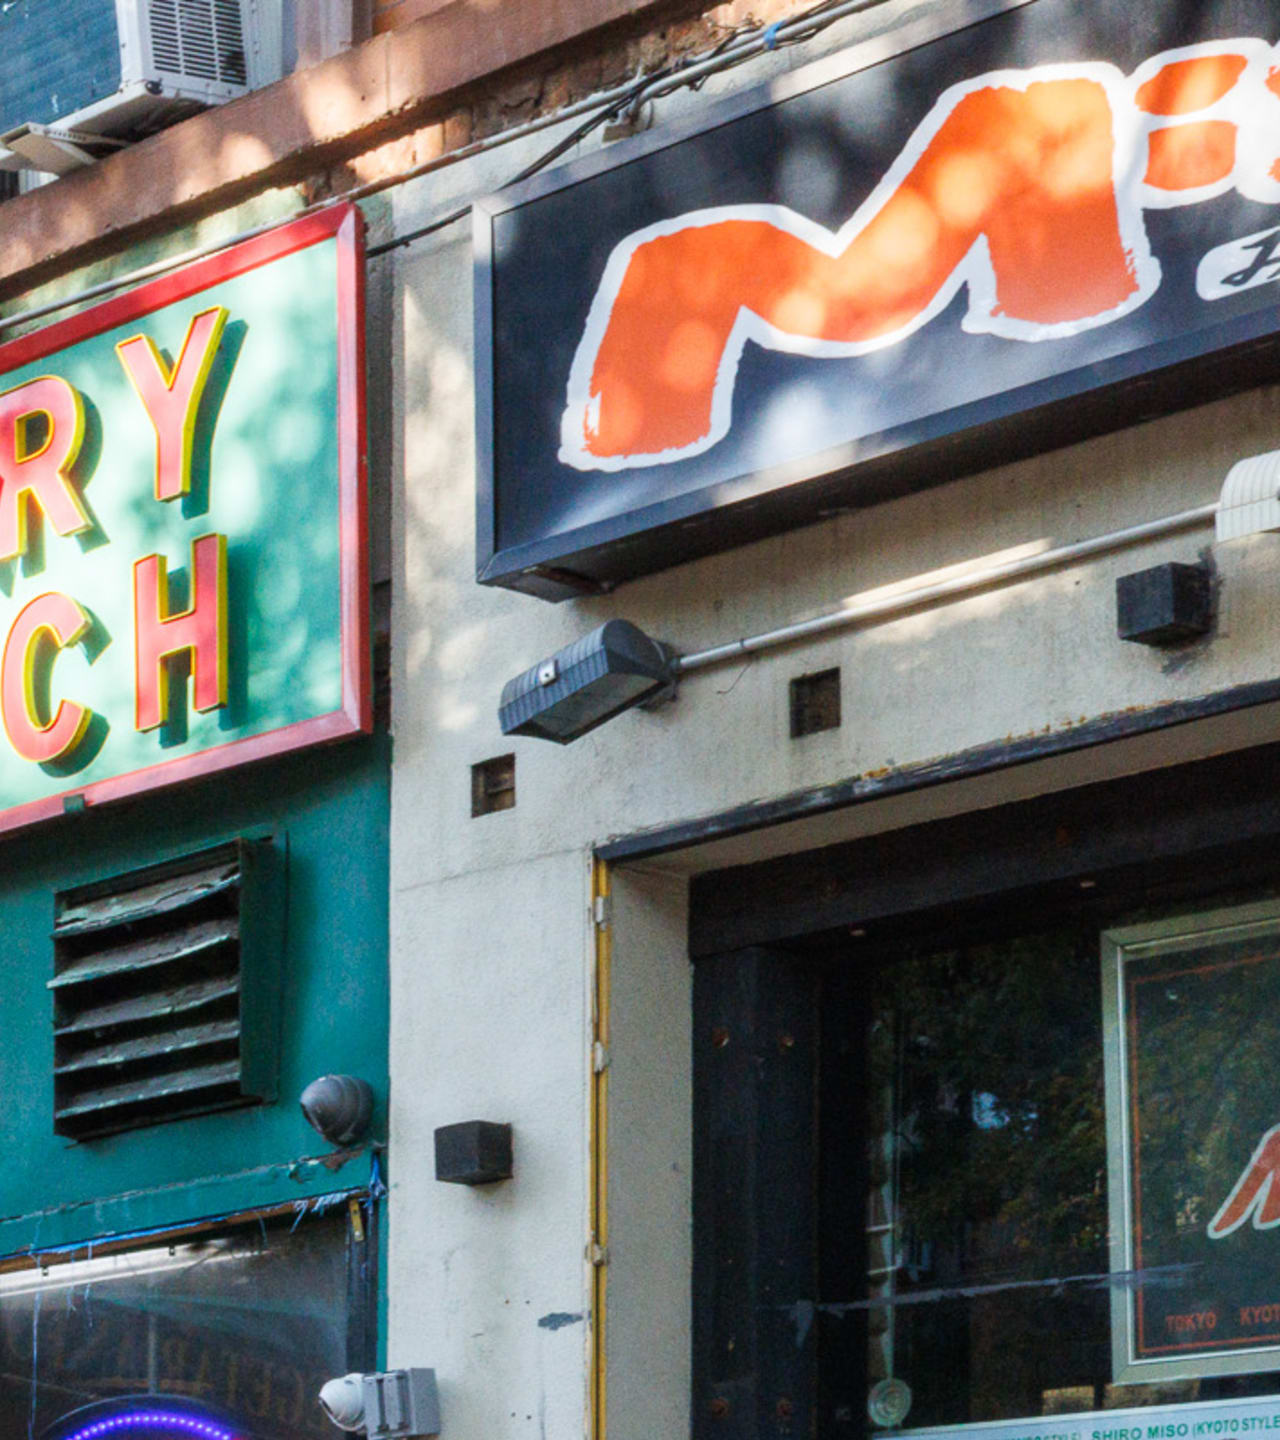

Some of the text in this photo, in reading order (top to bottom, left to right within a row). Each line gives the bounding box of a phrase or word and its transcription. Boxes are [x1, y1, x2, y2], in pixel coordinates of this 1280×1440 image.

[1166, 1311, 1216, 1332] TOKYO
[1147, 1423, 1188, 1439] MISO
[1193, 1418, 1240, 1437] (KYOTO
